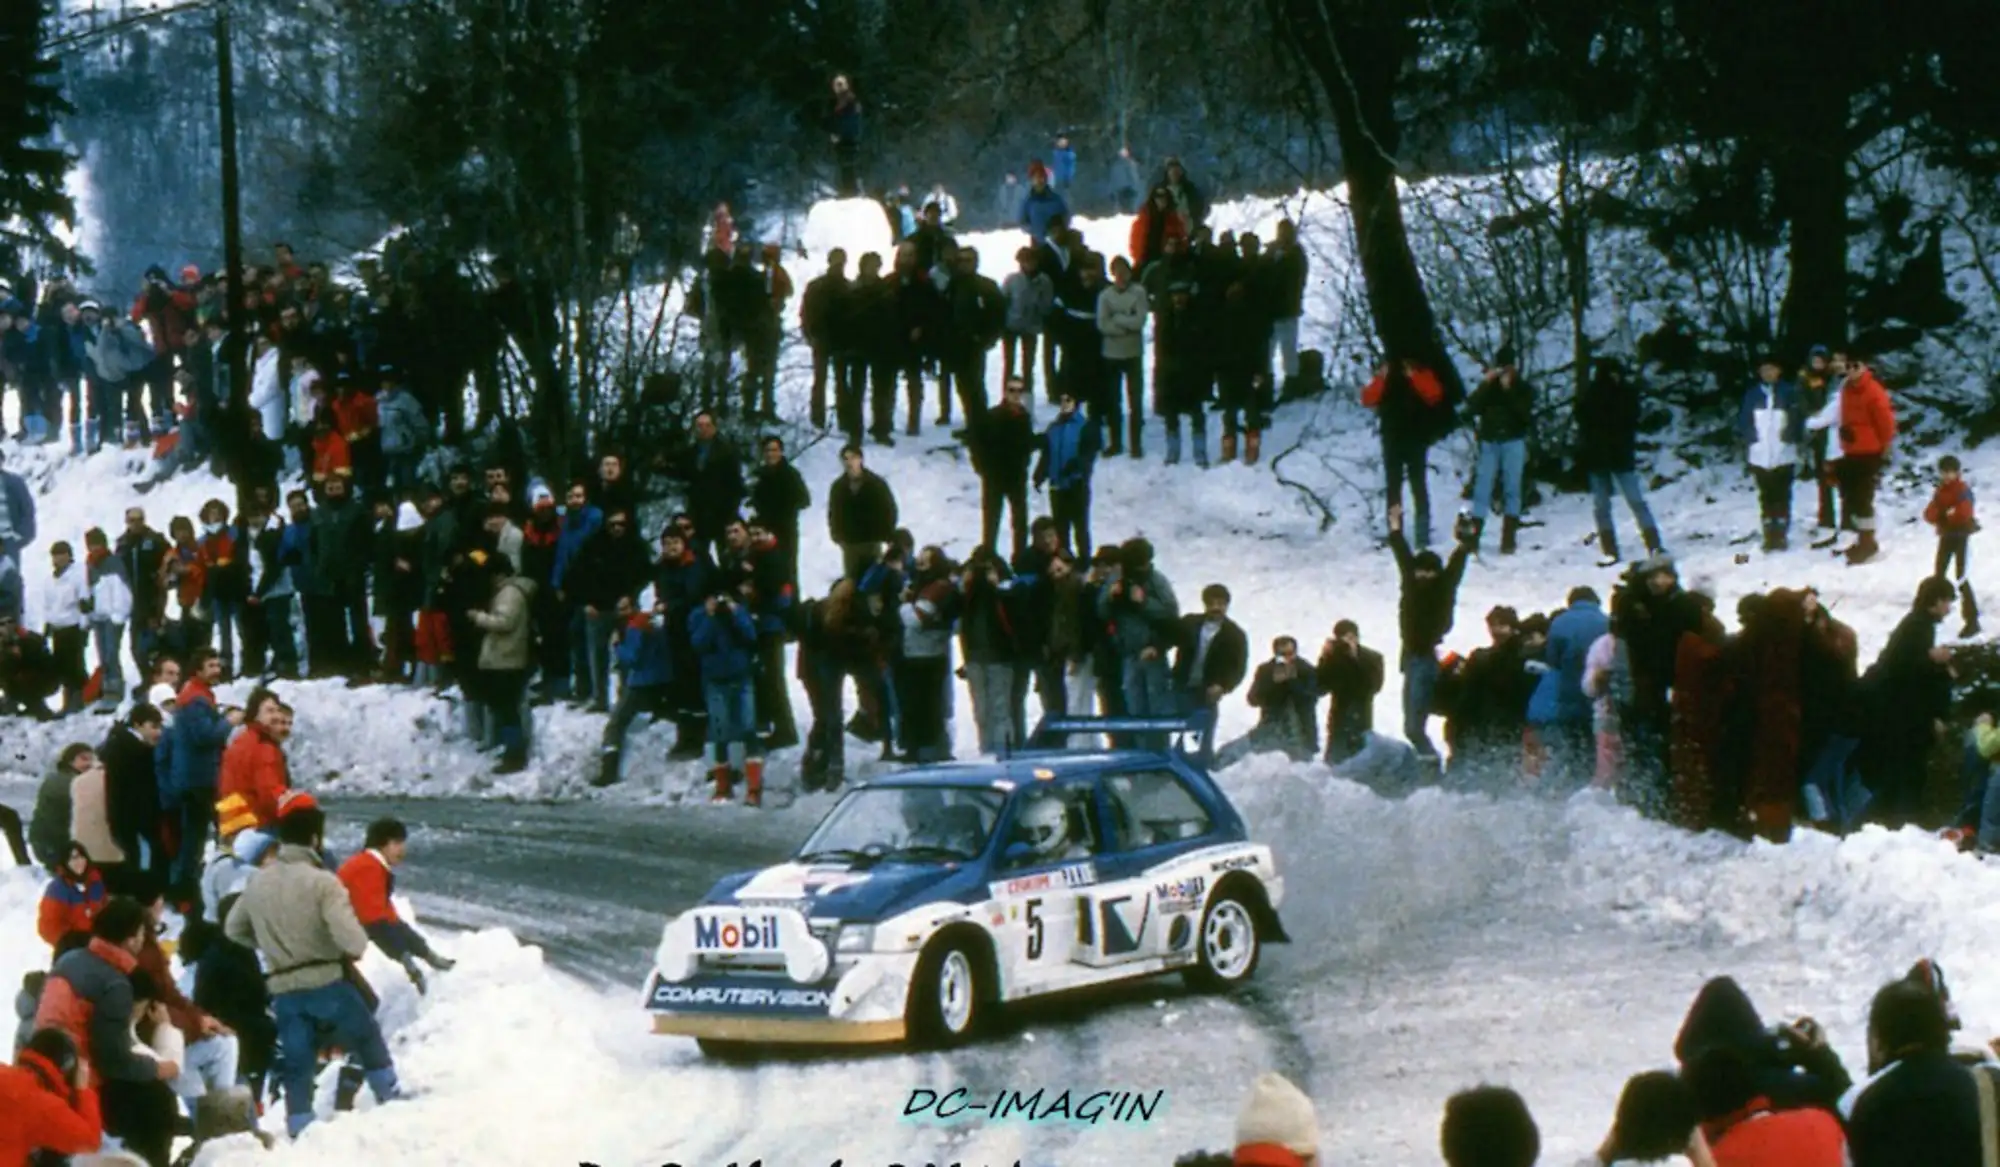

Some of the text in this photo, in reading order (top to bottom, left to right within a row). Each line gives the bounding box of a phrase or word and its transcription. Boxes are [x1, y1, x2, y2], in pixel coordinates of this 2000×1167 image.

[694, 915, 778, 949] Mobil
[1026, 898, 1044, 960] 5
[654, 986, 833, 1006] COMPUTERVISION
